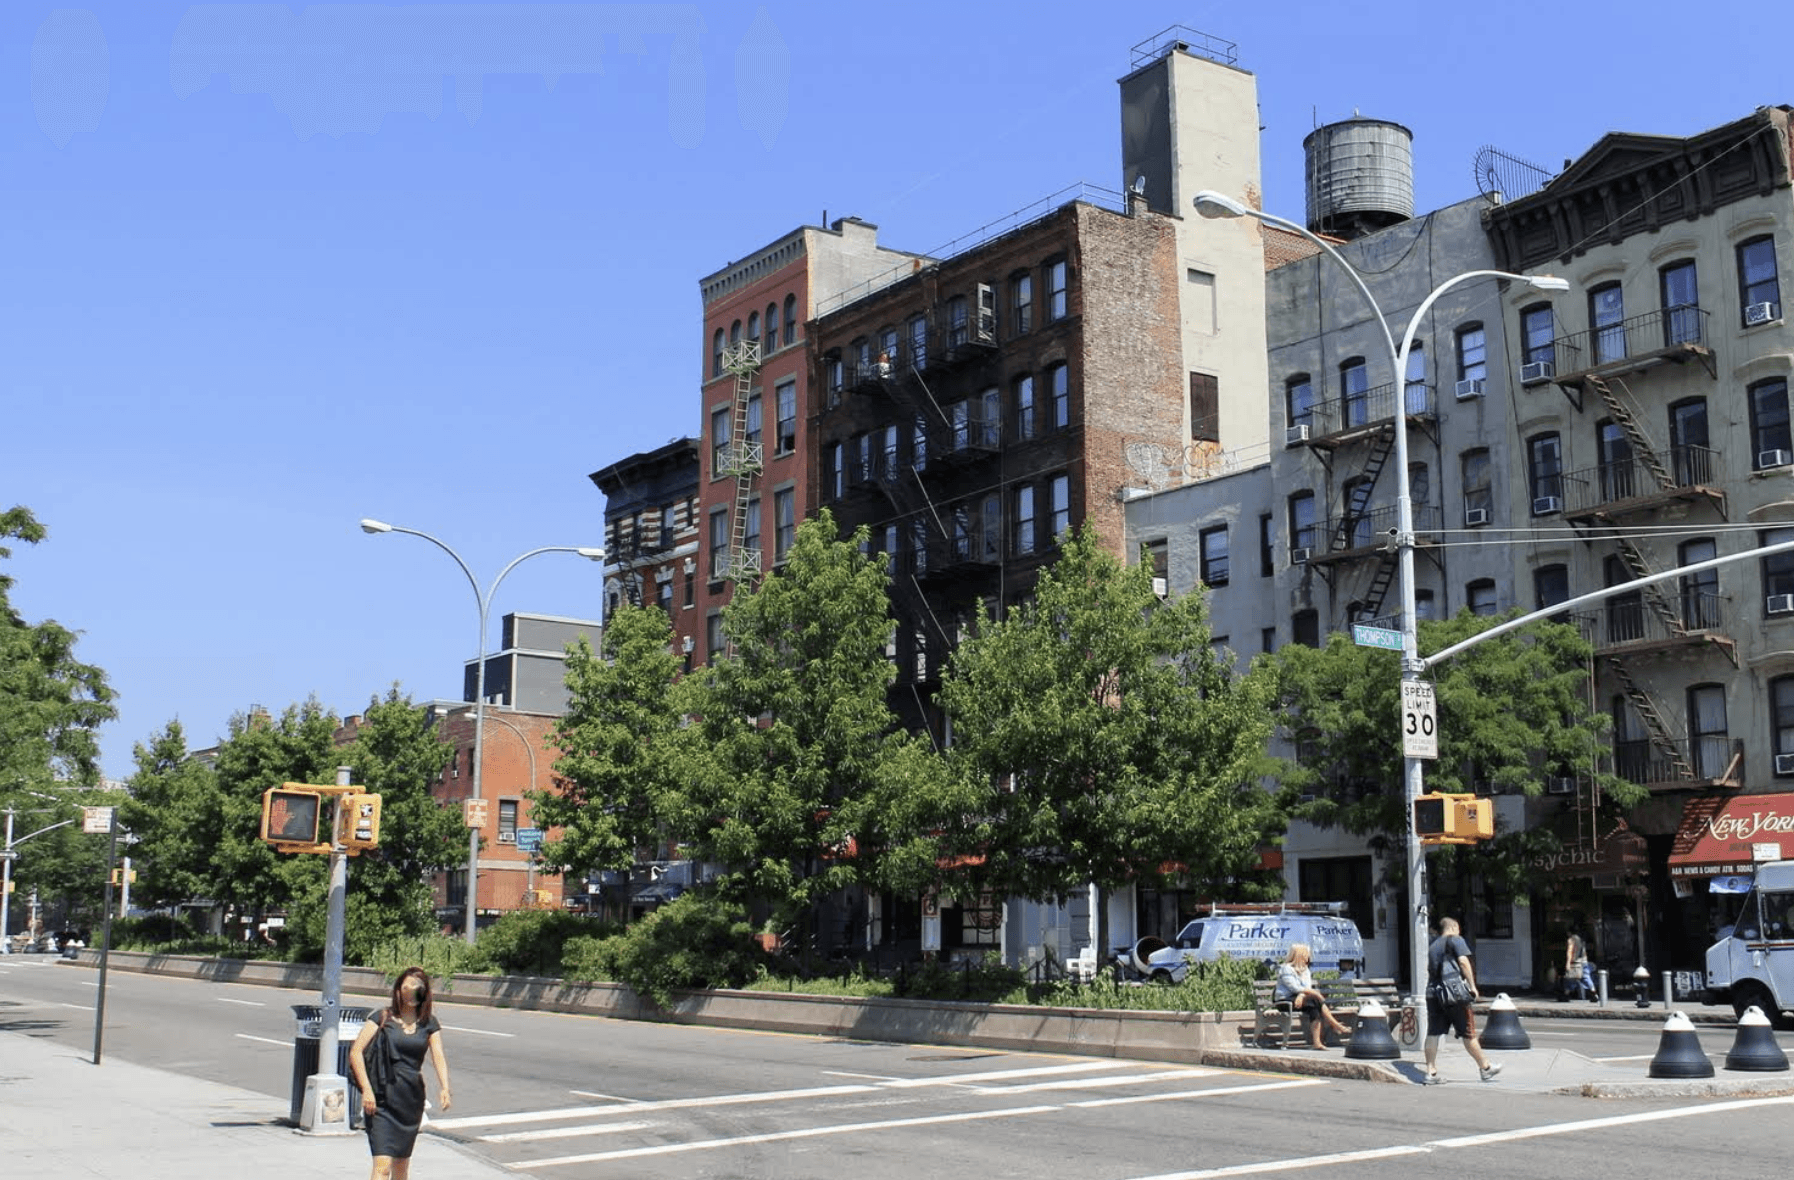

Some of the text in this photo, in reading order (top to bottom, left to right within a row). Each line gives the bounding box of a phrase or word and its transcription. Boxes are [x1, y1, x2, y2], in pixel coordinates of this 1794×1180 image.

[1355, 628, 1395, 646] THOMPSON
[1404, 686, 1432, 698] SPEED
[1407, 700, 1431, 711] LIMIT
[1406, 712, 1434, 736] 30
[1526, 848, 1604, 871] sychic
[1229, 922, 1290, 939] Parker
[1316, 925, 1353, 936] Parker
